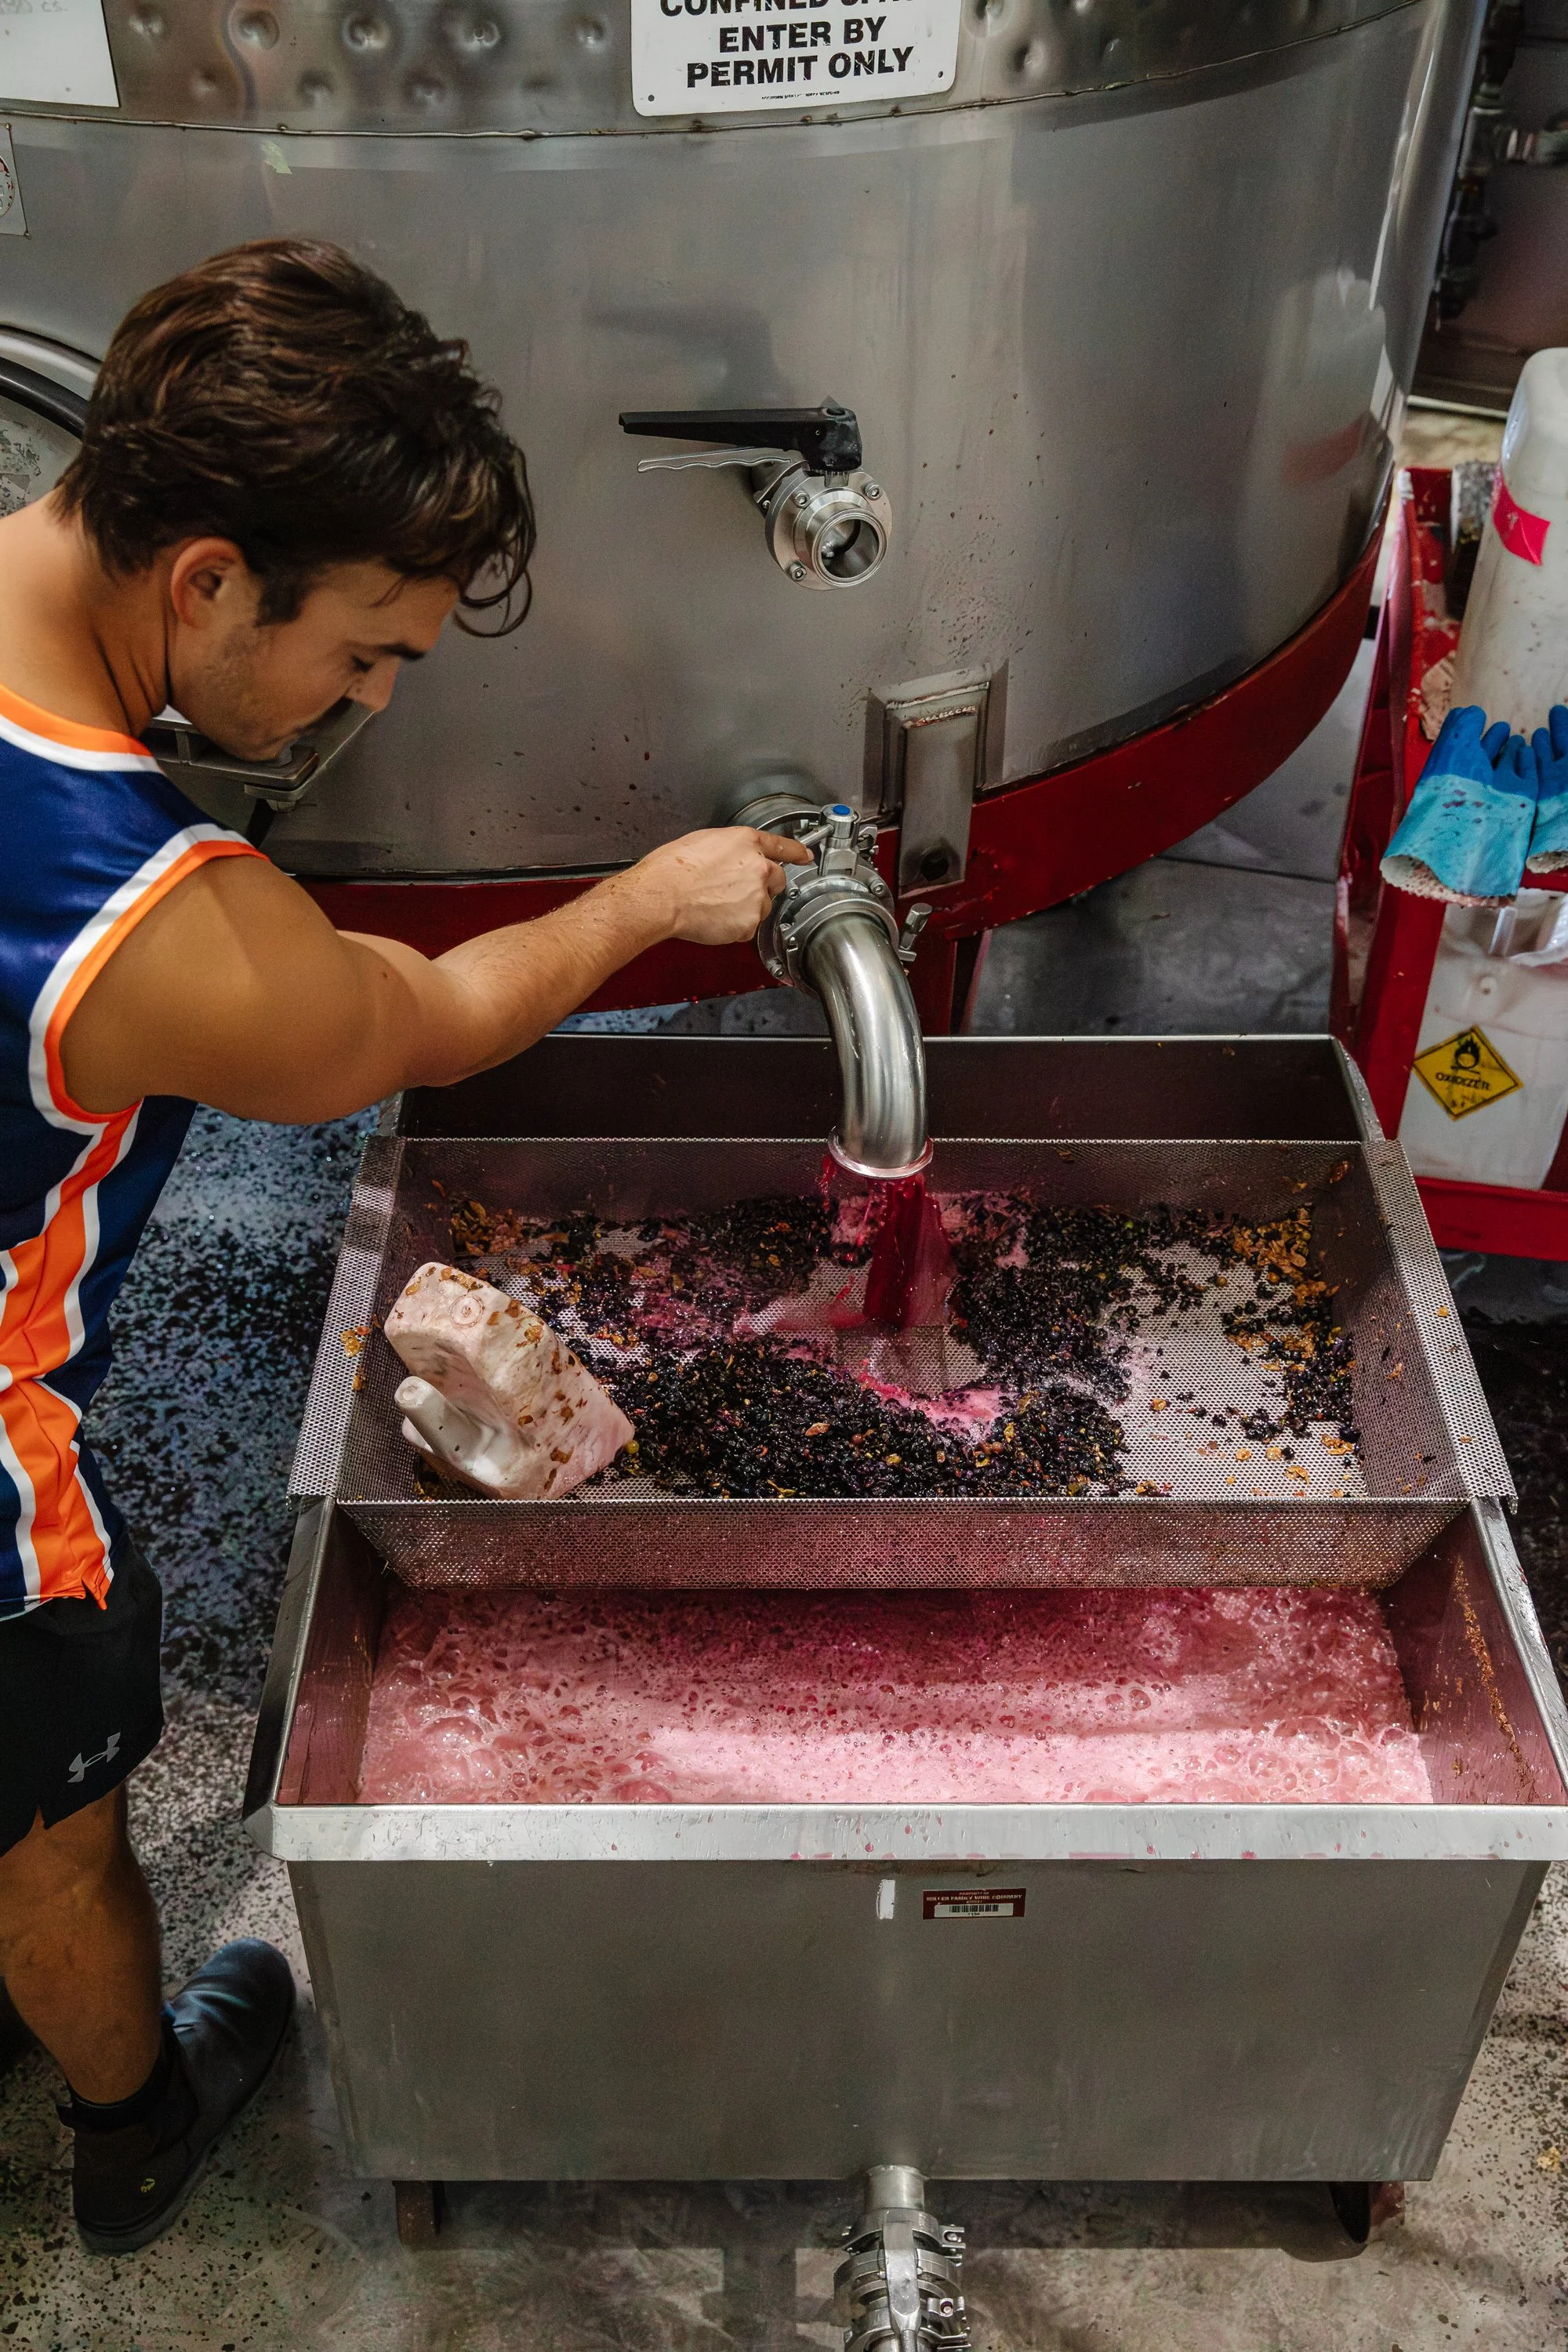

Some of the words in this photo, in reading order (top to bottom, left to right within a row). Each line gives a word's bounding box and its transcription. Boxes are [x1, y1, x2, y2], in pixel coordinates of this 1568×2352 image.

[719, 22, 831, 53] ENTER
[844, 16, 887, 45] BY
[687, 56, 818, 88] PERMIT
[828, 46, 914, 78] ONLY
[1436, 1073, 1490, 1091] OXIDIZER
